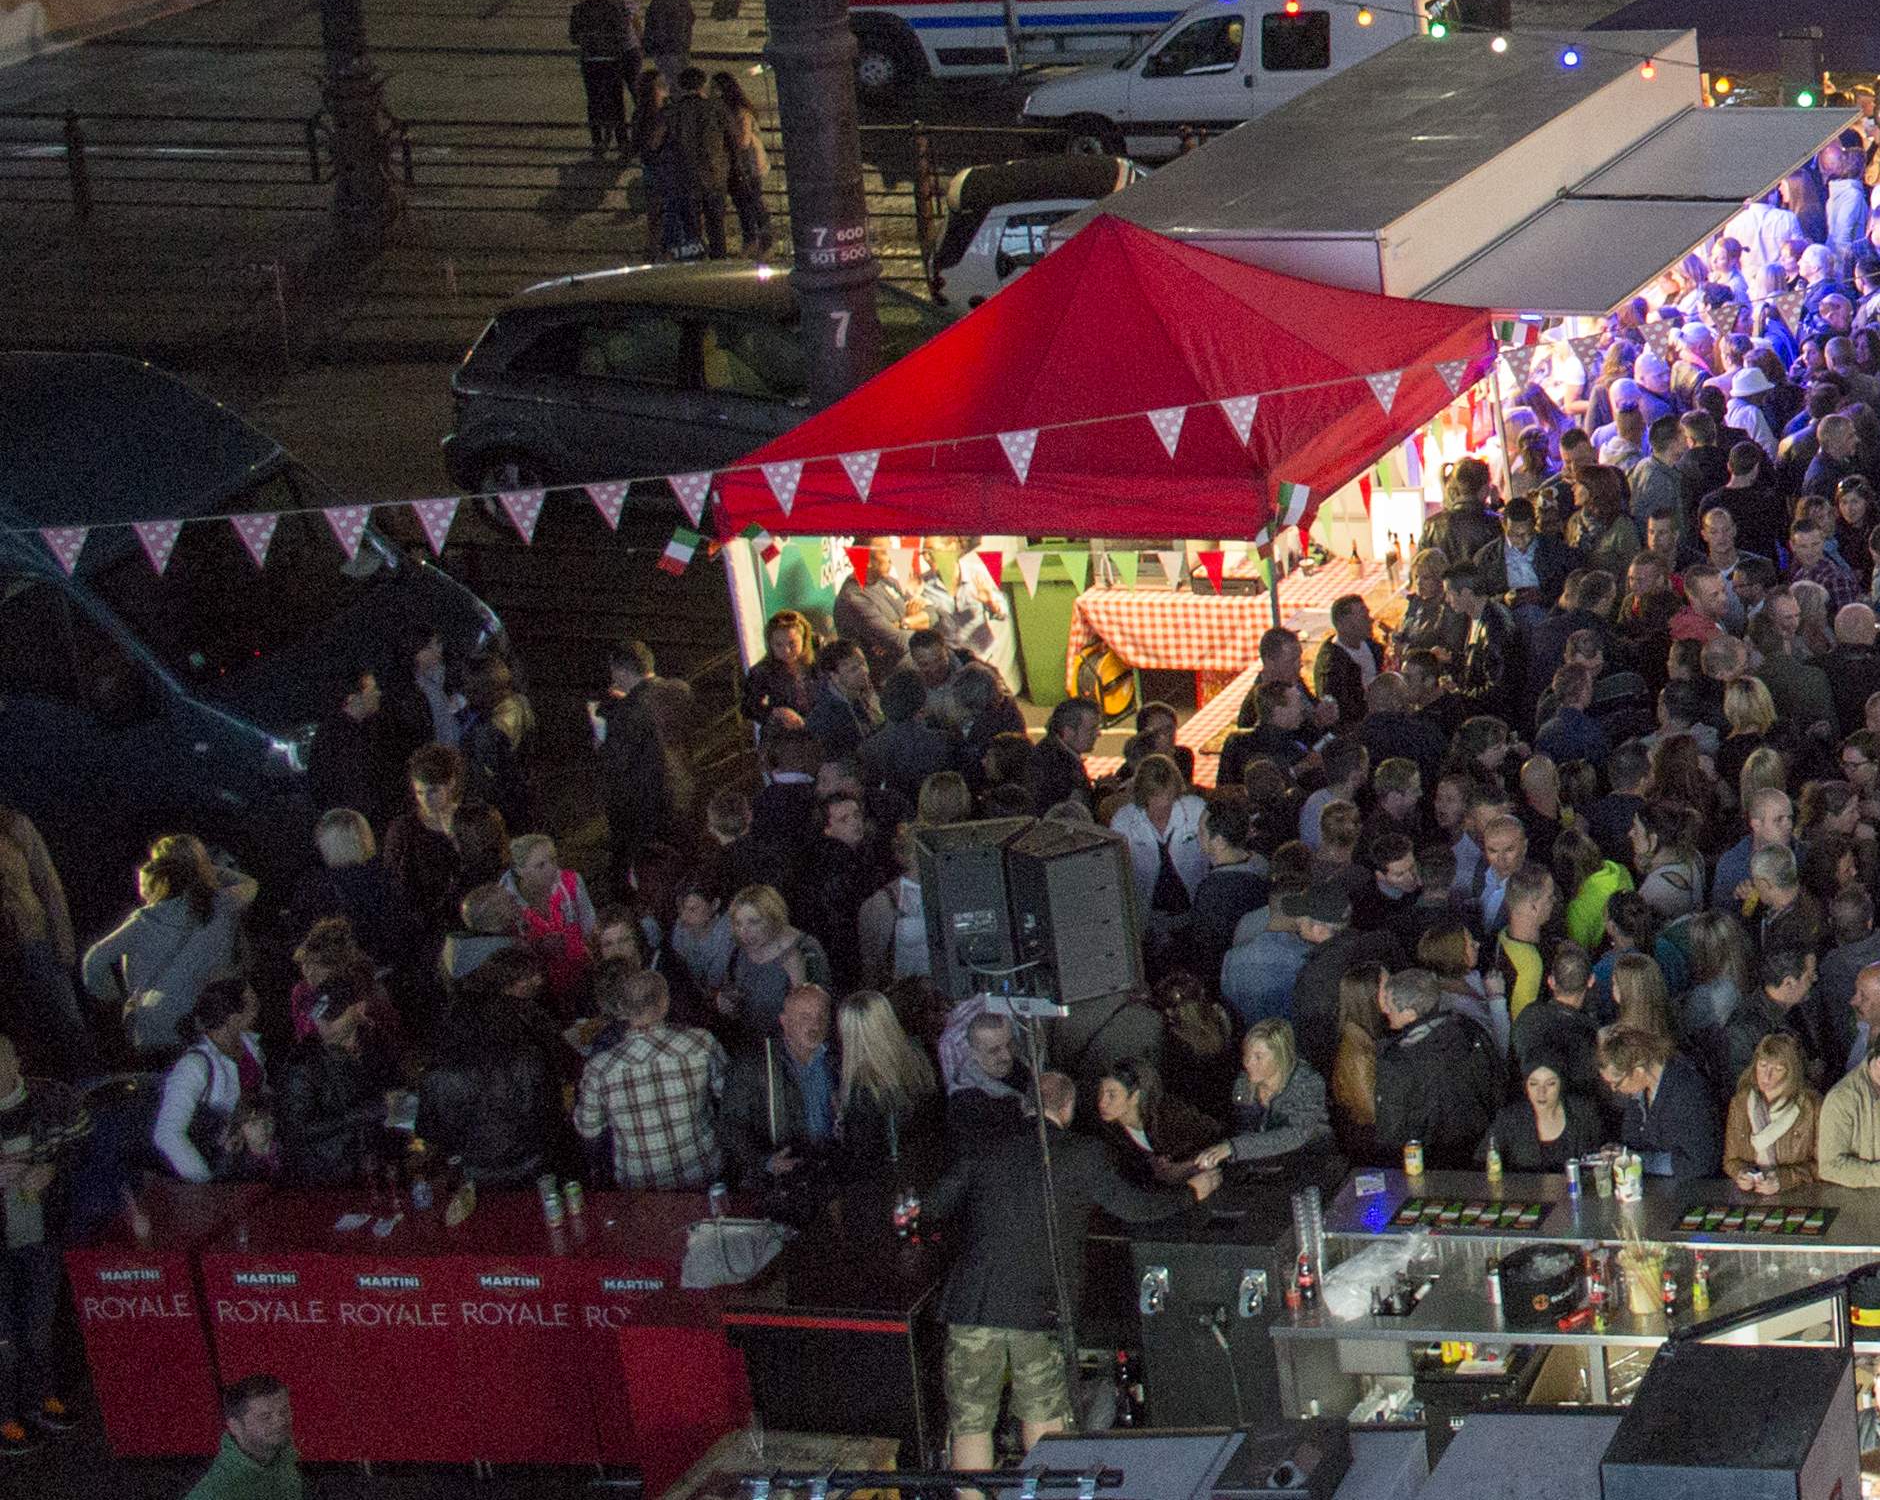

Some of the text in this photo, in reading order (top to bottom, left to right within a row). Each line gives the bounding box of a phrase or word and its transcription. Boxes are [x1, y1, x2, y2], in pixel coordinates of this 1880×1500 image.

[811, 227, 829, 248] 7
[829, 309, 852, 349] 7
[100, 1269, 160, 1281] MARTINI
[236, 1273, 297, 1285] MARTINI
[358, 1276, 420, 1288] MARTINI
[480, 1276, 541, 1288] MARTINI
[603, 1279, 664, 1290] MARTINI
[83, 1294, 193, 1320] ROYALE
[216, 1300, 327, 1324] ROYALE
[340, 1303, 450, 1326] ROYALE
[461, 1302, 569, 1327] ROYALE
